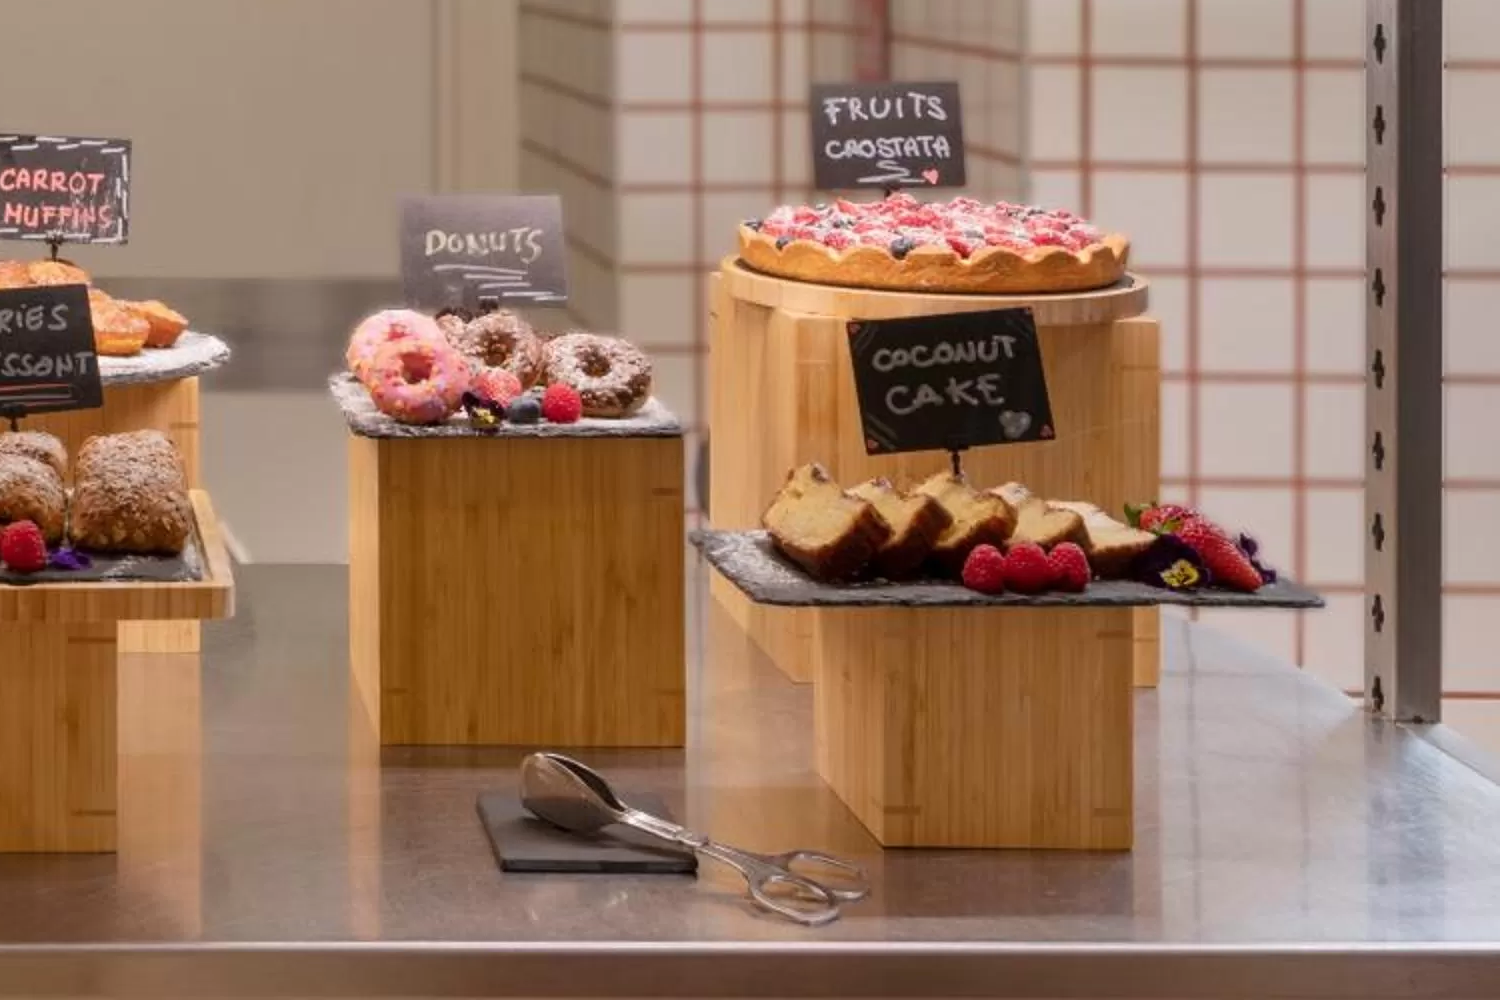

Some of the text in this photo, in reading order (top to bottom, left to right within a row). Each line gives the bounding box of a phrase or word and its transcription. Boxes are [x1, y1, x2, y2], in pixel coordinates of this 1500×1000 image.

[823, 91, 948, 126] FRUITS
[825, 134, 951, 160] CROSTATA
[3, 201, 113, 230] MUFFINS
[424, 226, 544, 265] DONUTS
[871, 334, 1017, 373] COCONUT
[885, 373, 1005, 416] CAKE
